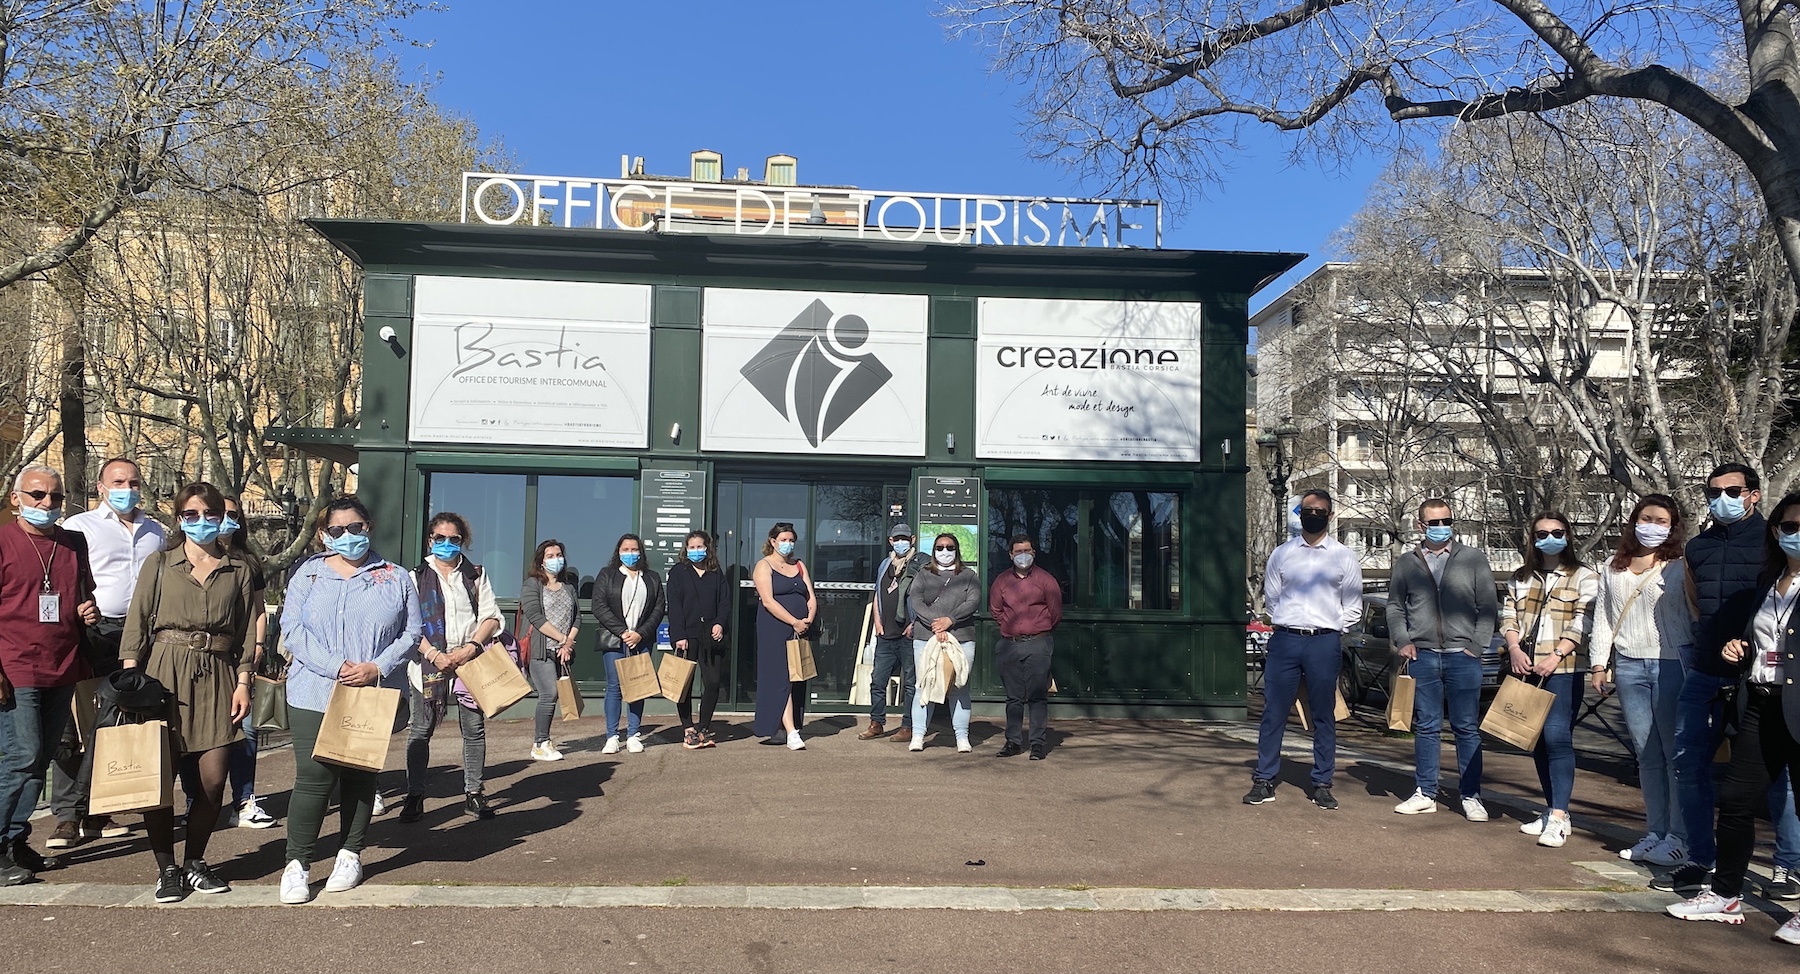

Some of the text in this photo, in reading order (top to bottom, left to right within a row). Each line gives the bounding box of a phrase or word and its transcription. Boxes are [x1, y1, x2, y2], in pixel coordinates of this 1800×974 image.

[474, 177, 1143, 249] OFFICE DE TOURISME
[452, 321, 606, 378] Bastia
[459, 375, 607, 388] OFFICE DE TOURISME INTERCOMMUNAL
[1041, 384, 1058, 397] Art
[1061, 384, 1073, 397] de
[1068, 399, 1136, 418] mode et design
[341, 715, 375, 731] Bastia
[107, 759, 142, 775] Bastia
